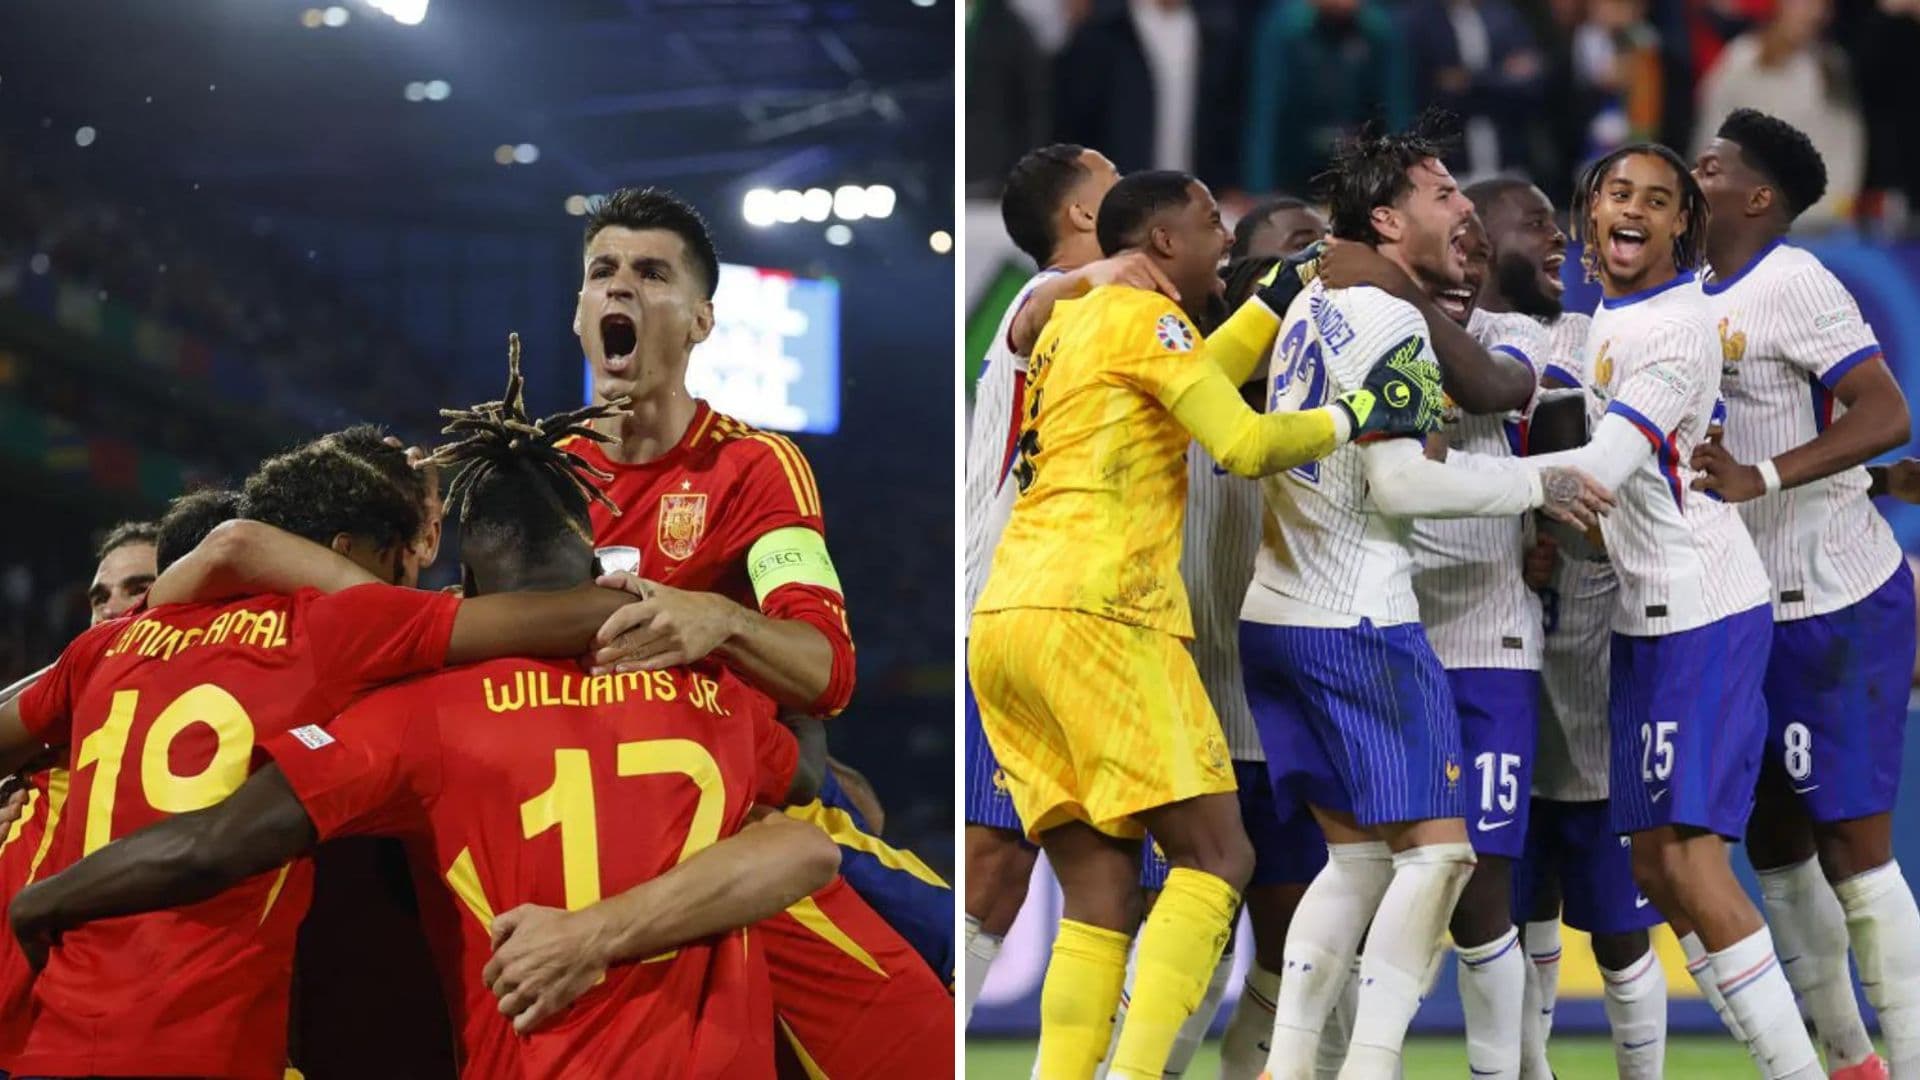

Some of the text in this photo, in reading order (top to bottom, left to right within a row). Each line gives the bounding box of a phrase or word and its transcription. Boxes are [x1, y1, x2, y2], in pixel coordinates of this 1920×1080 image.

[482, 669, 731, 717] WILLIAMS JR.
[1641, 721, 1679, 782] 25
[1784, 721, 1812, 781] 8
[1474, 751, 1521, 815] 15
[520, 738, 726, 966] 17
